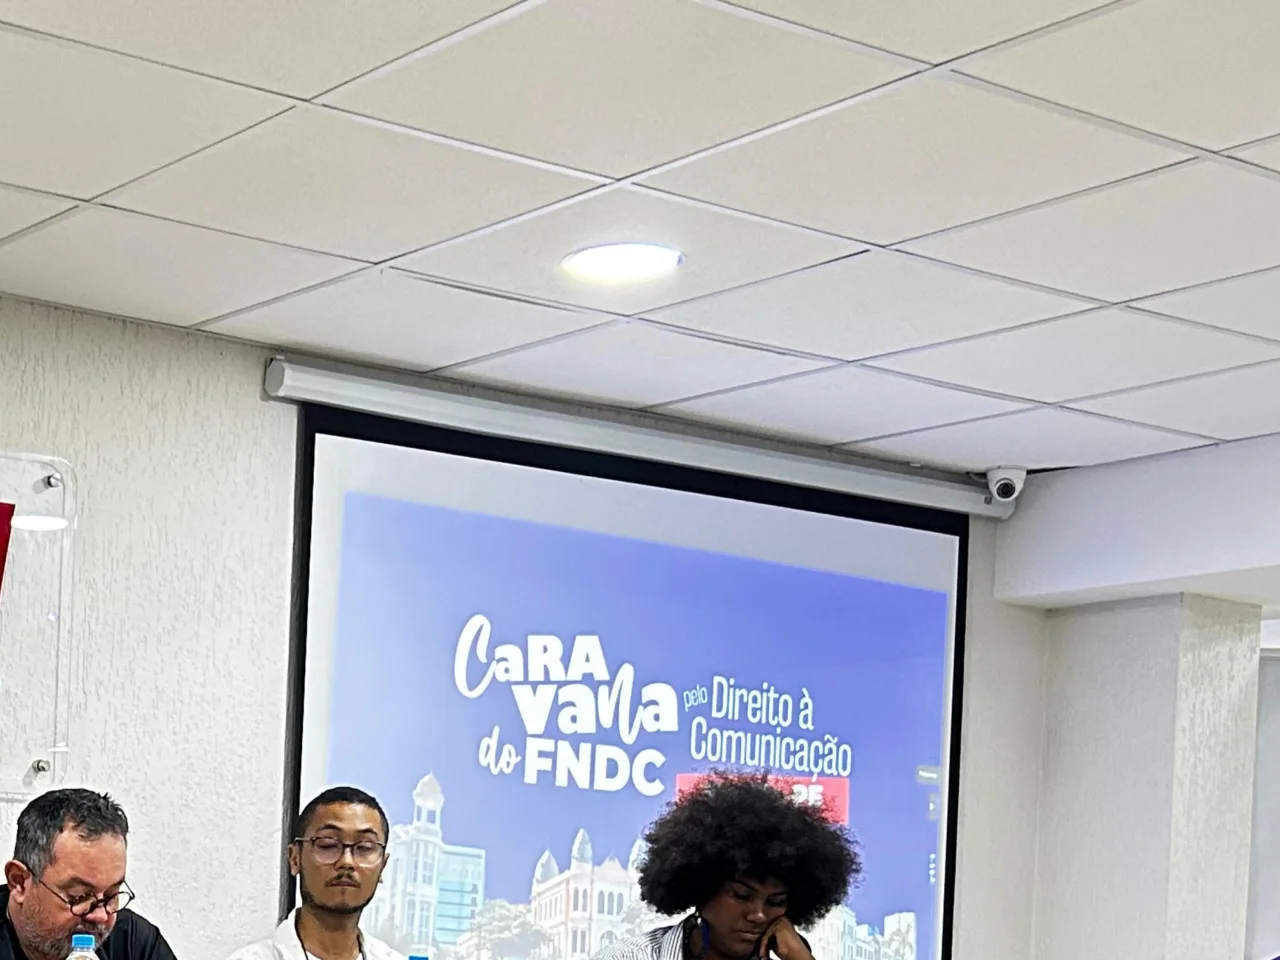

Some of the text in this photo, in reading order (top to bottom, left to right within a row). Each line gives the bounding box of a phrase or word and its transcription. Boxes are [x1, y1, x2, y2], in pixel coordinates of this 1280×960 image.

[683, 675, 814, 730] pelo Direito à
[478, 725, 666, 796] do FNDC
[690, 716, 852, 782] Comunicação
